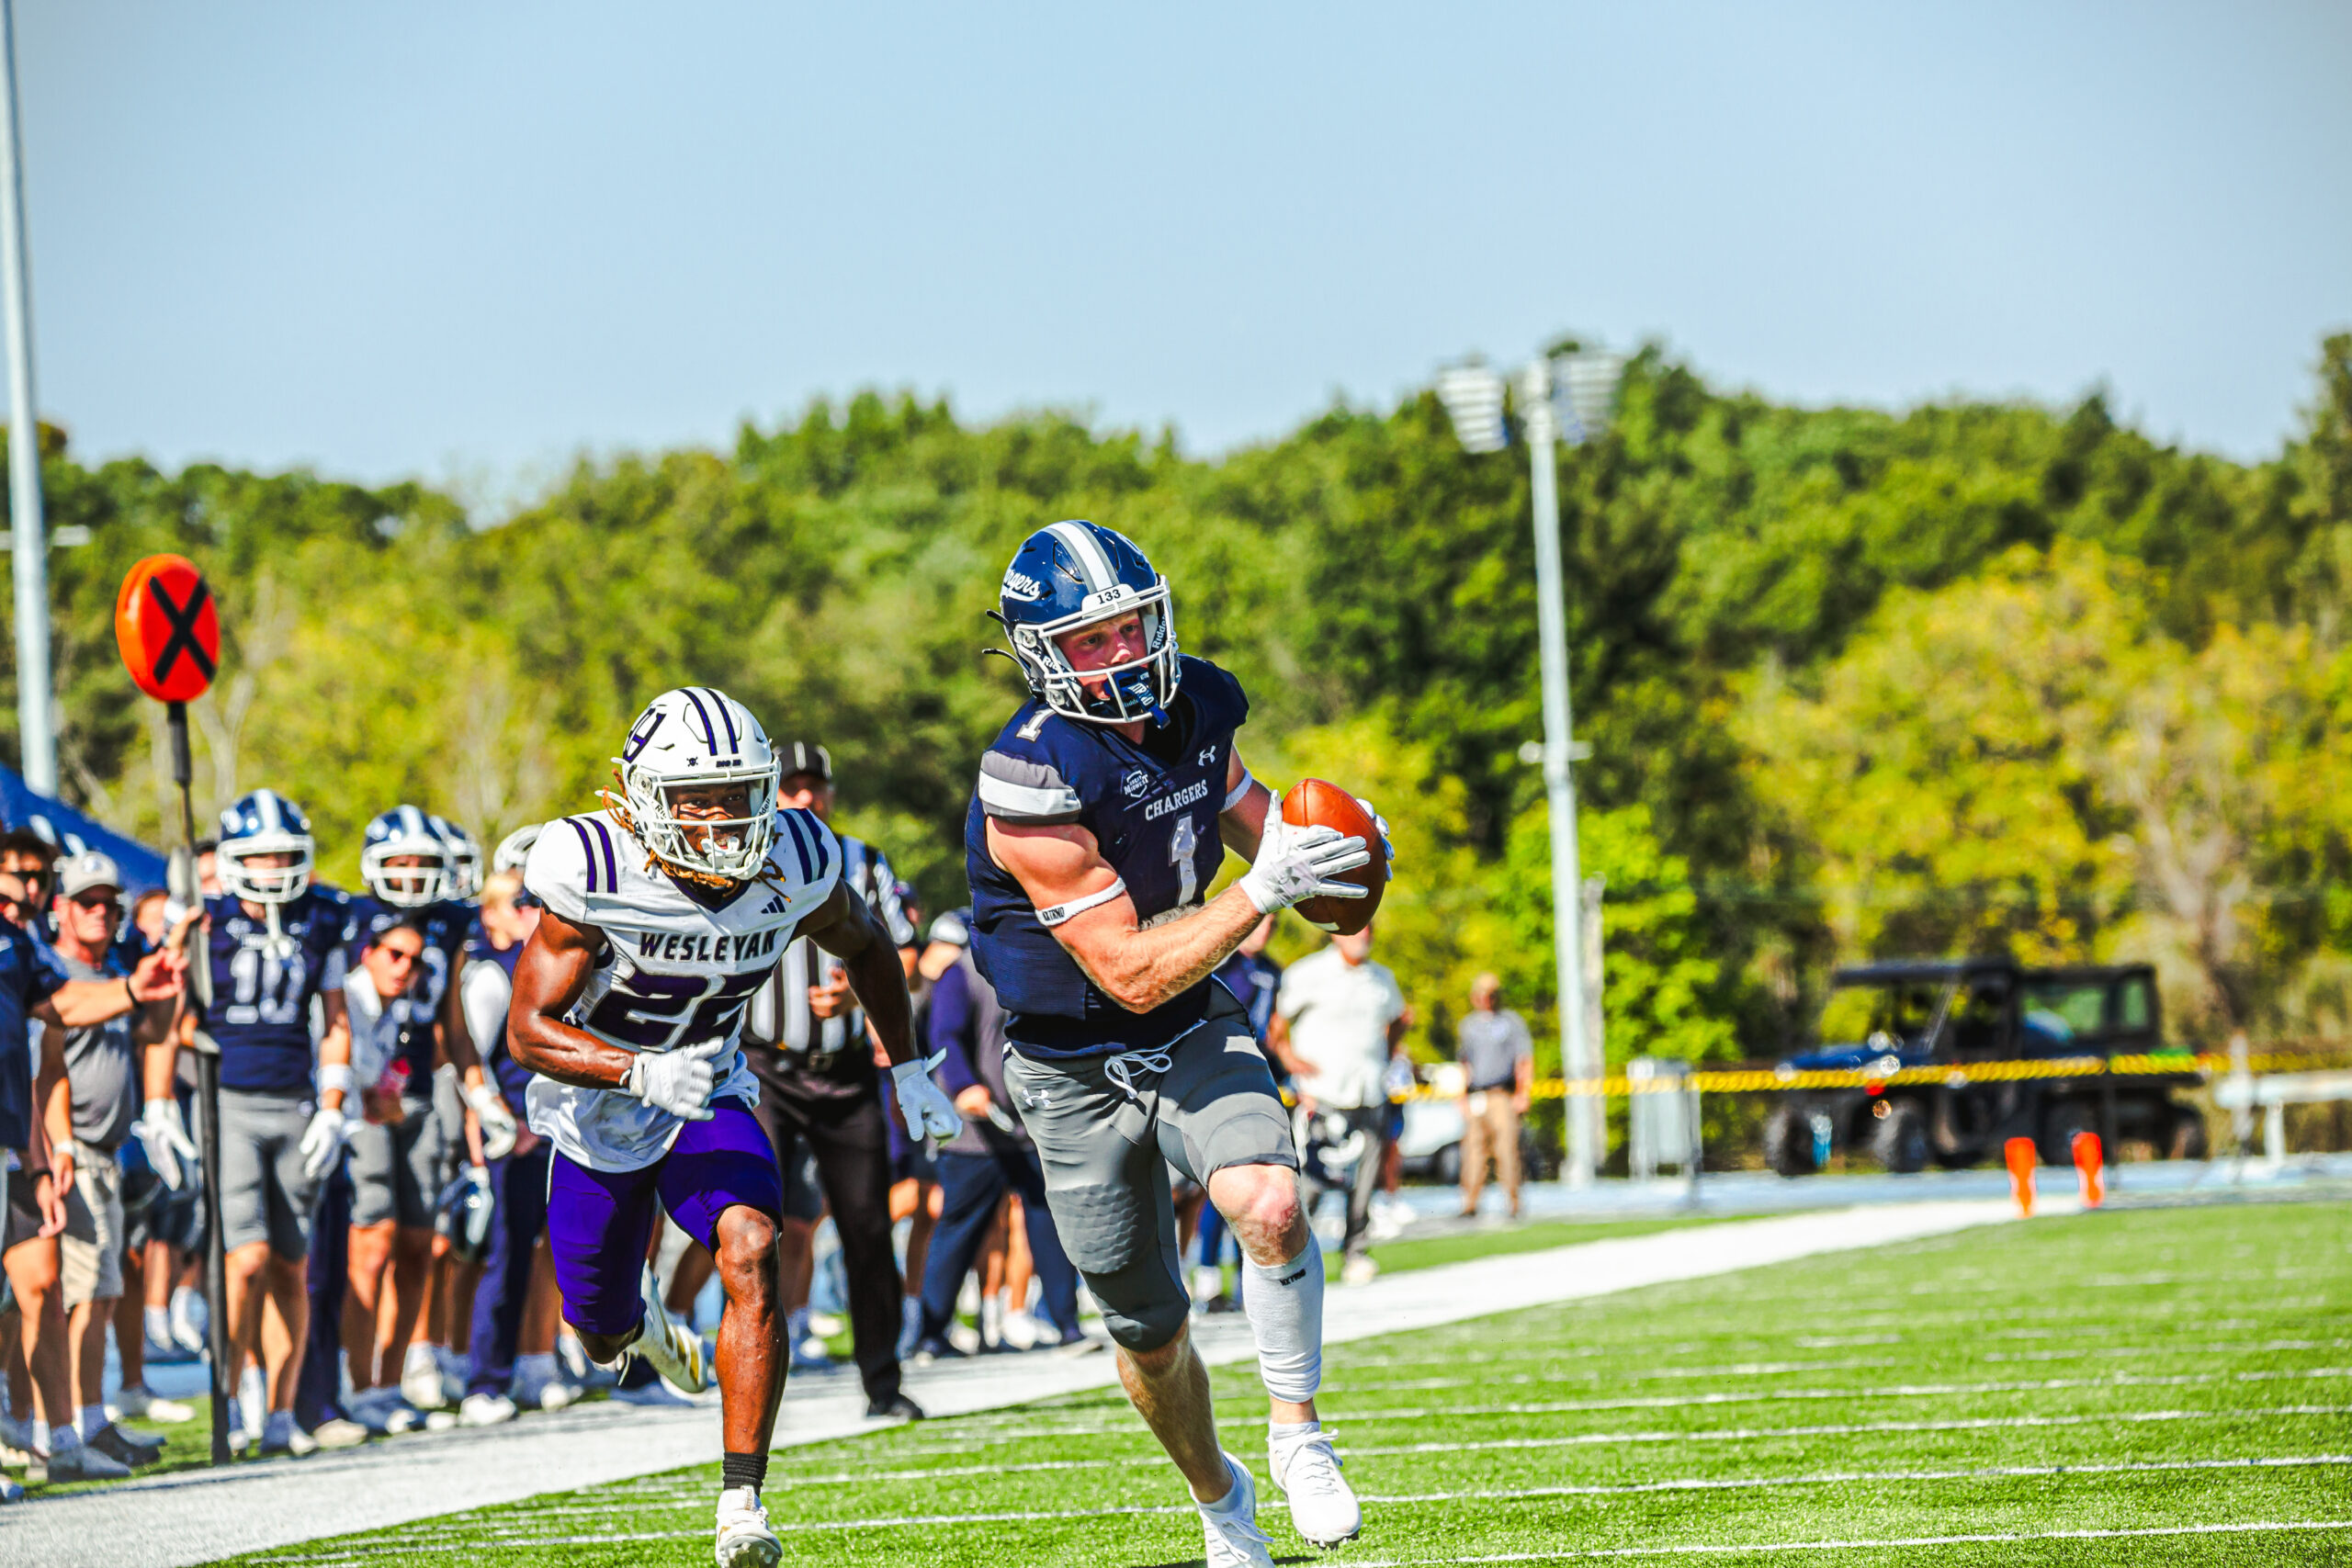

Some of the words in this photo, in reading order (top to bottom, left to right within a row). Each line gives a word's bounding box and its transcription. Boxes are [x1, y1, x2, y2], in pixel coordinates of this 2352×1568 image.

[1097, 589, 1121, 604] 133
[150, 576, 215, 685] X
[1145, 779, 1208, 821] CHARGERS
[1169, 811, 1198, 908] 1
[639, 928, 780, 962] WESLEYAN
[226, 948, 306, 1024] 10
